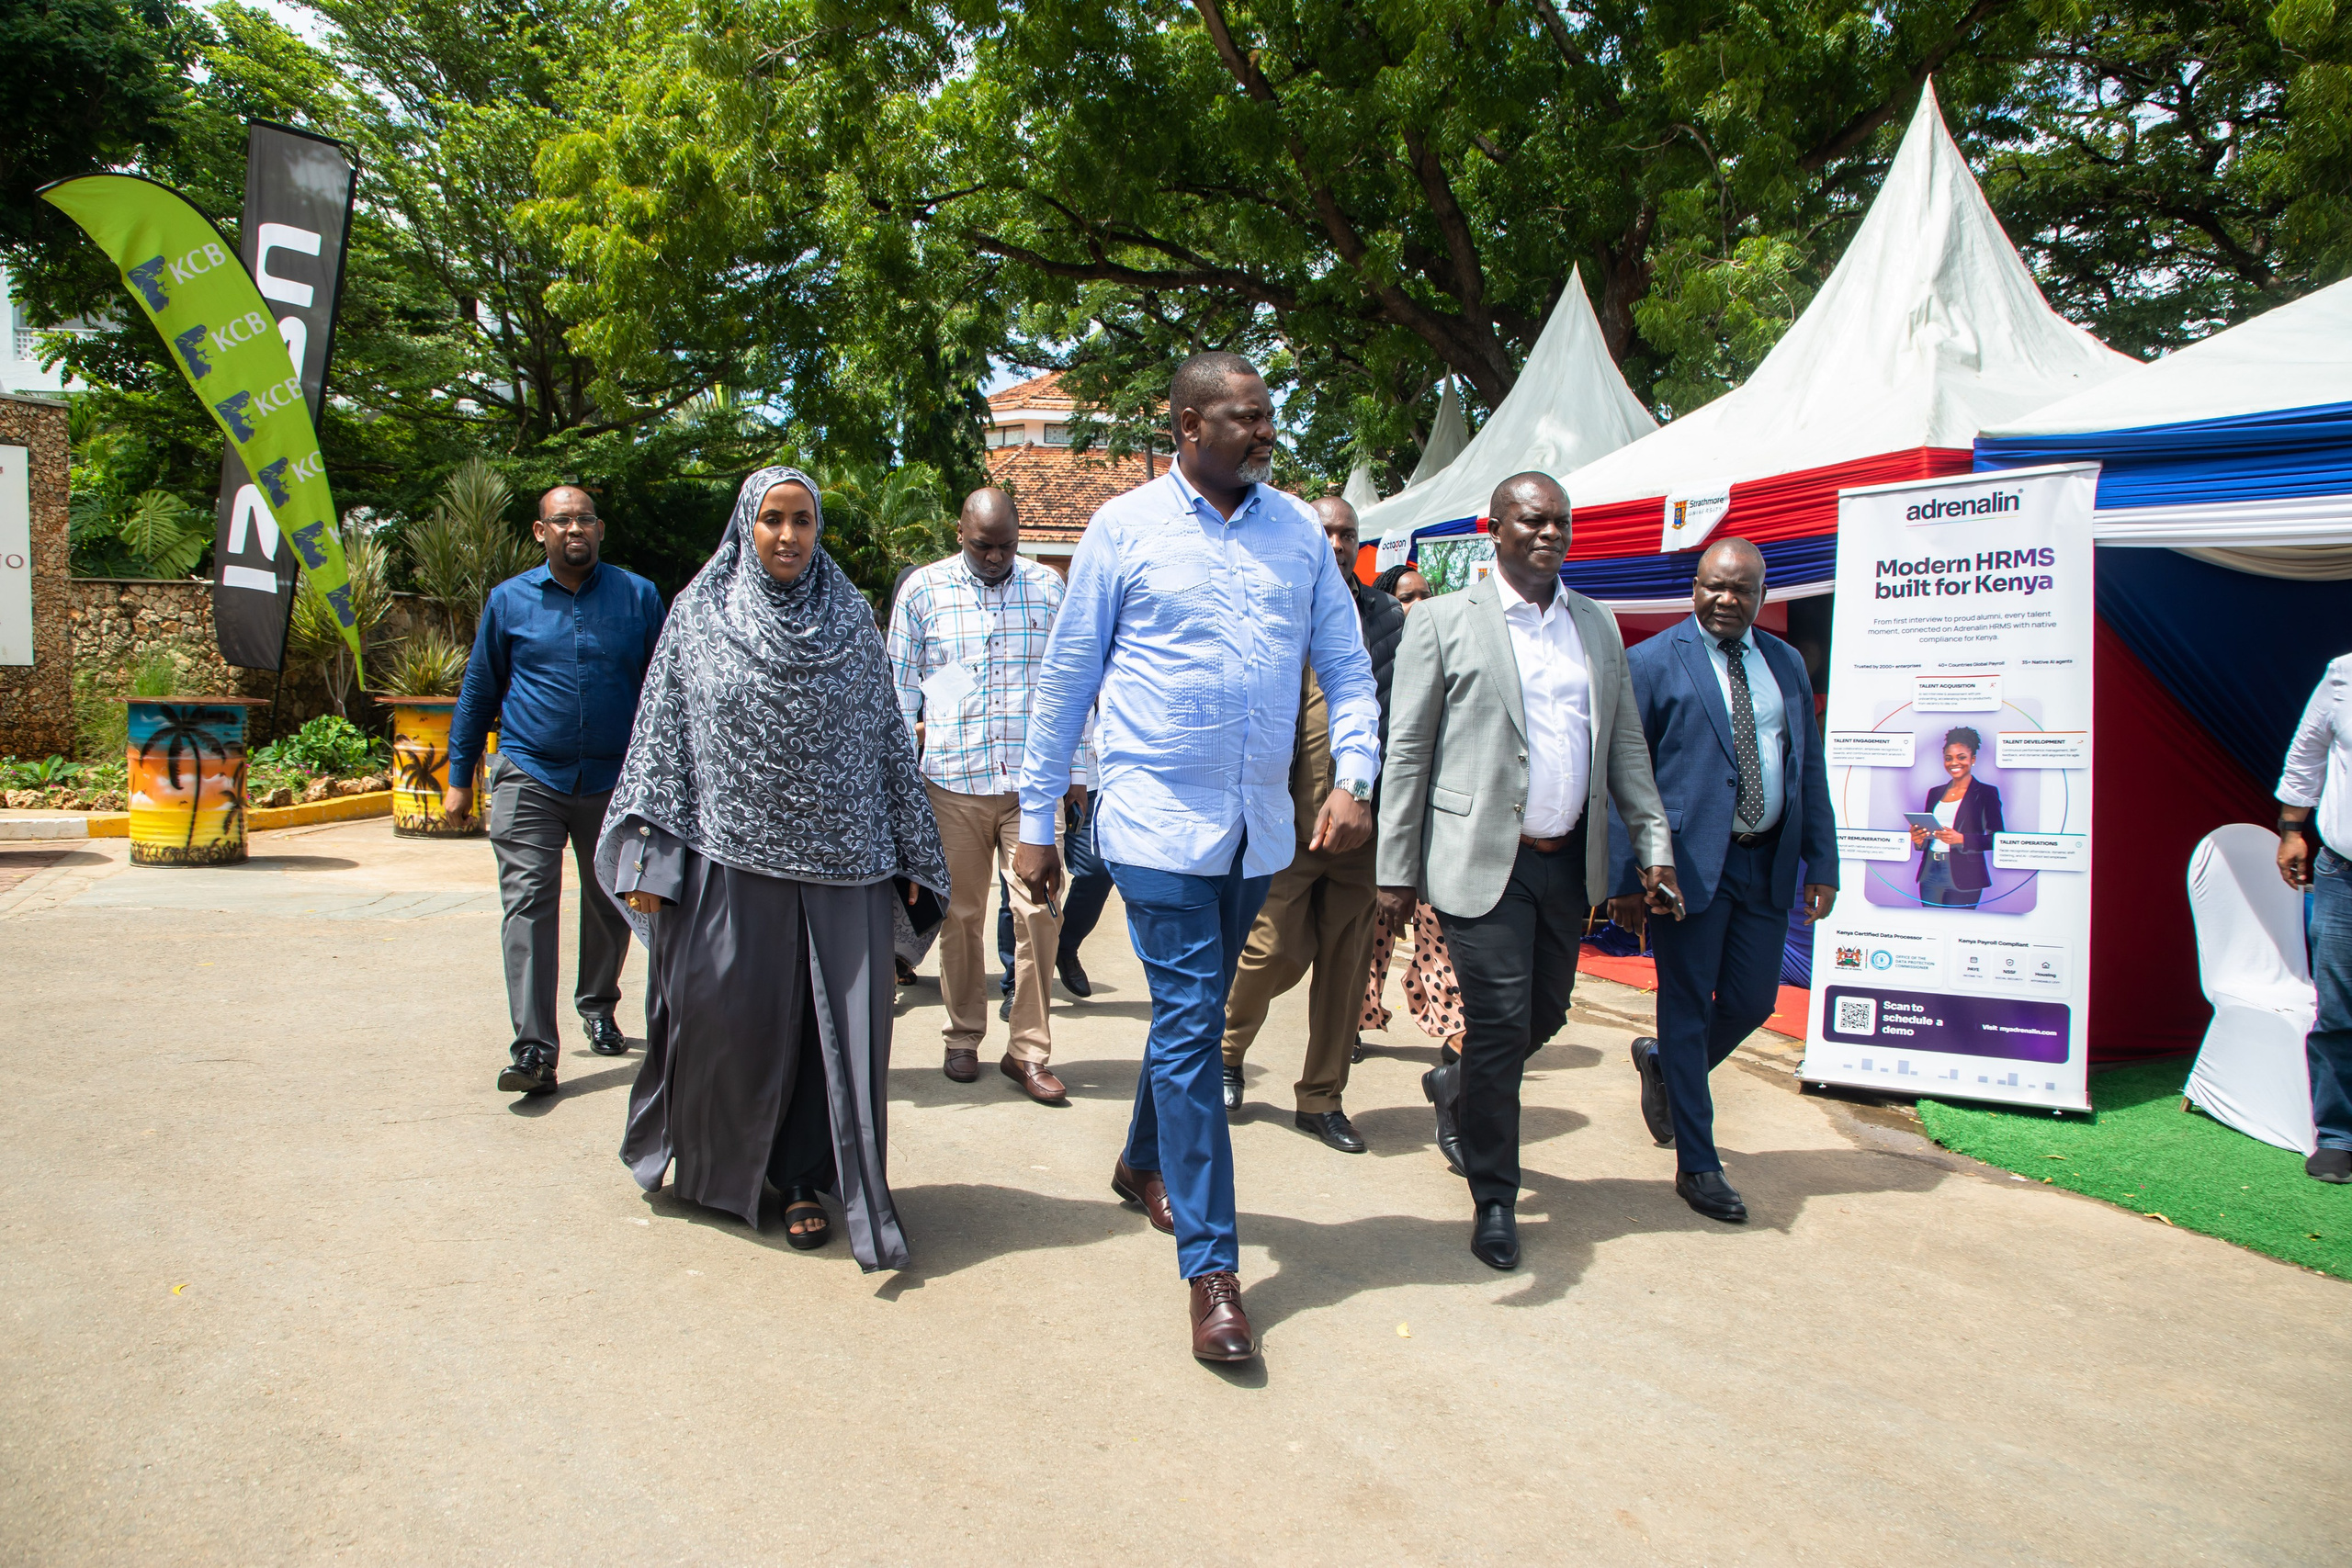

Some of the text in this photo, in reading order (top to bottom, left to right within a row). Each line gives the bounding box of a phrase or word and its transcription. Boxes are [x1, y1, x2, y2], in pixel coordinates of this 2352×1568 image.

[168, 243, 226, 285] KCB
[210, 311, 267, 353] KCB
[254, 377, 305, 417] KCB
[291, 450, 325, 483] KC
[1690, 497, 1724, 508] Strathmore
[1688, 507, 1723, 516] UNIVERSITY
[1382, 539, 1407, 552] octagon
[0, 554, 24, 569] O
[1875, 547, 2056, 578] Modern HRMS
[1875, 574, 2054, 599] built for Kenya
[1919, 635, 1962, 644] compliance
[1883, 1001, 1924, 1013] Scan to
[1882, 1013, 1944, 1027] schedule a
[1882, 1025, 1915, 1036] demo
[1999, 1025, 2057, 1036] myadrenalin.com
